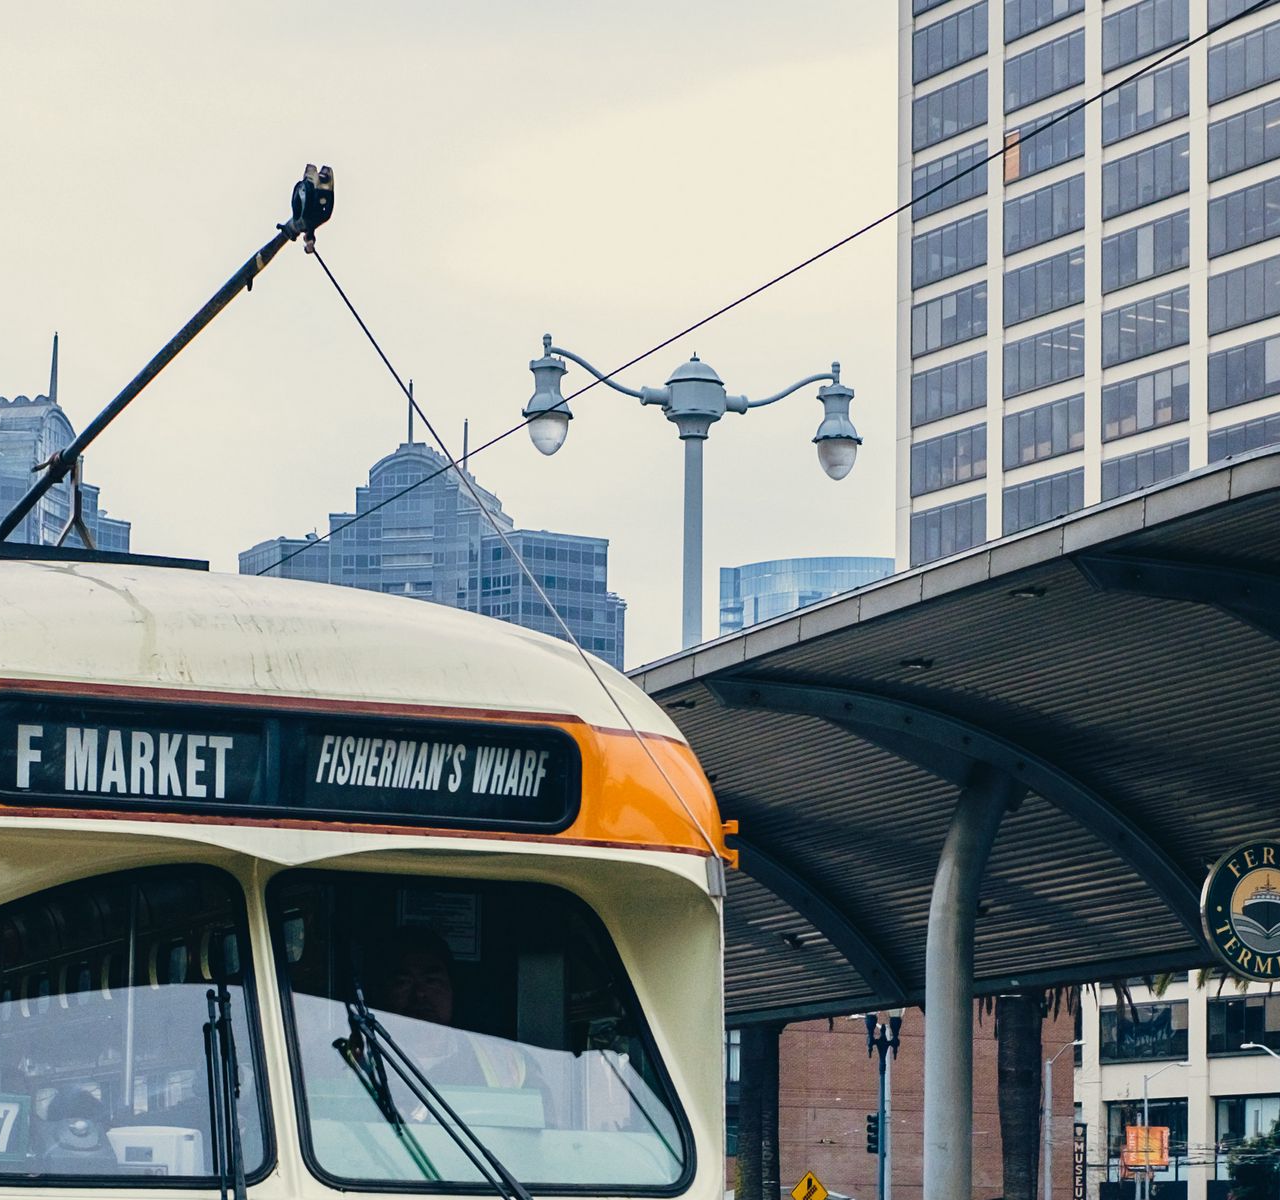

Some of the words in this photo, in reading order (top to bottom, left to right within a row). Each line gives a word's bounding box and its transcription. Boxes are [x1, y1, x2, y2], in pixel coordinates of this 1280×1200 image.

[17, 725, 43, 788] F
[65, 727, 234, 799] MARKET
[316, 735, 466, 793] FISHERMAN'S
[472, 746, 549, 797] WHARF
